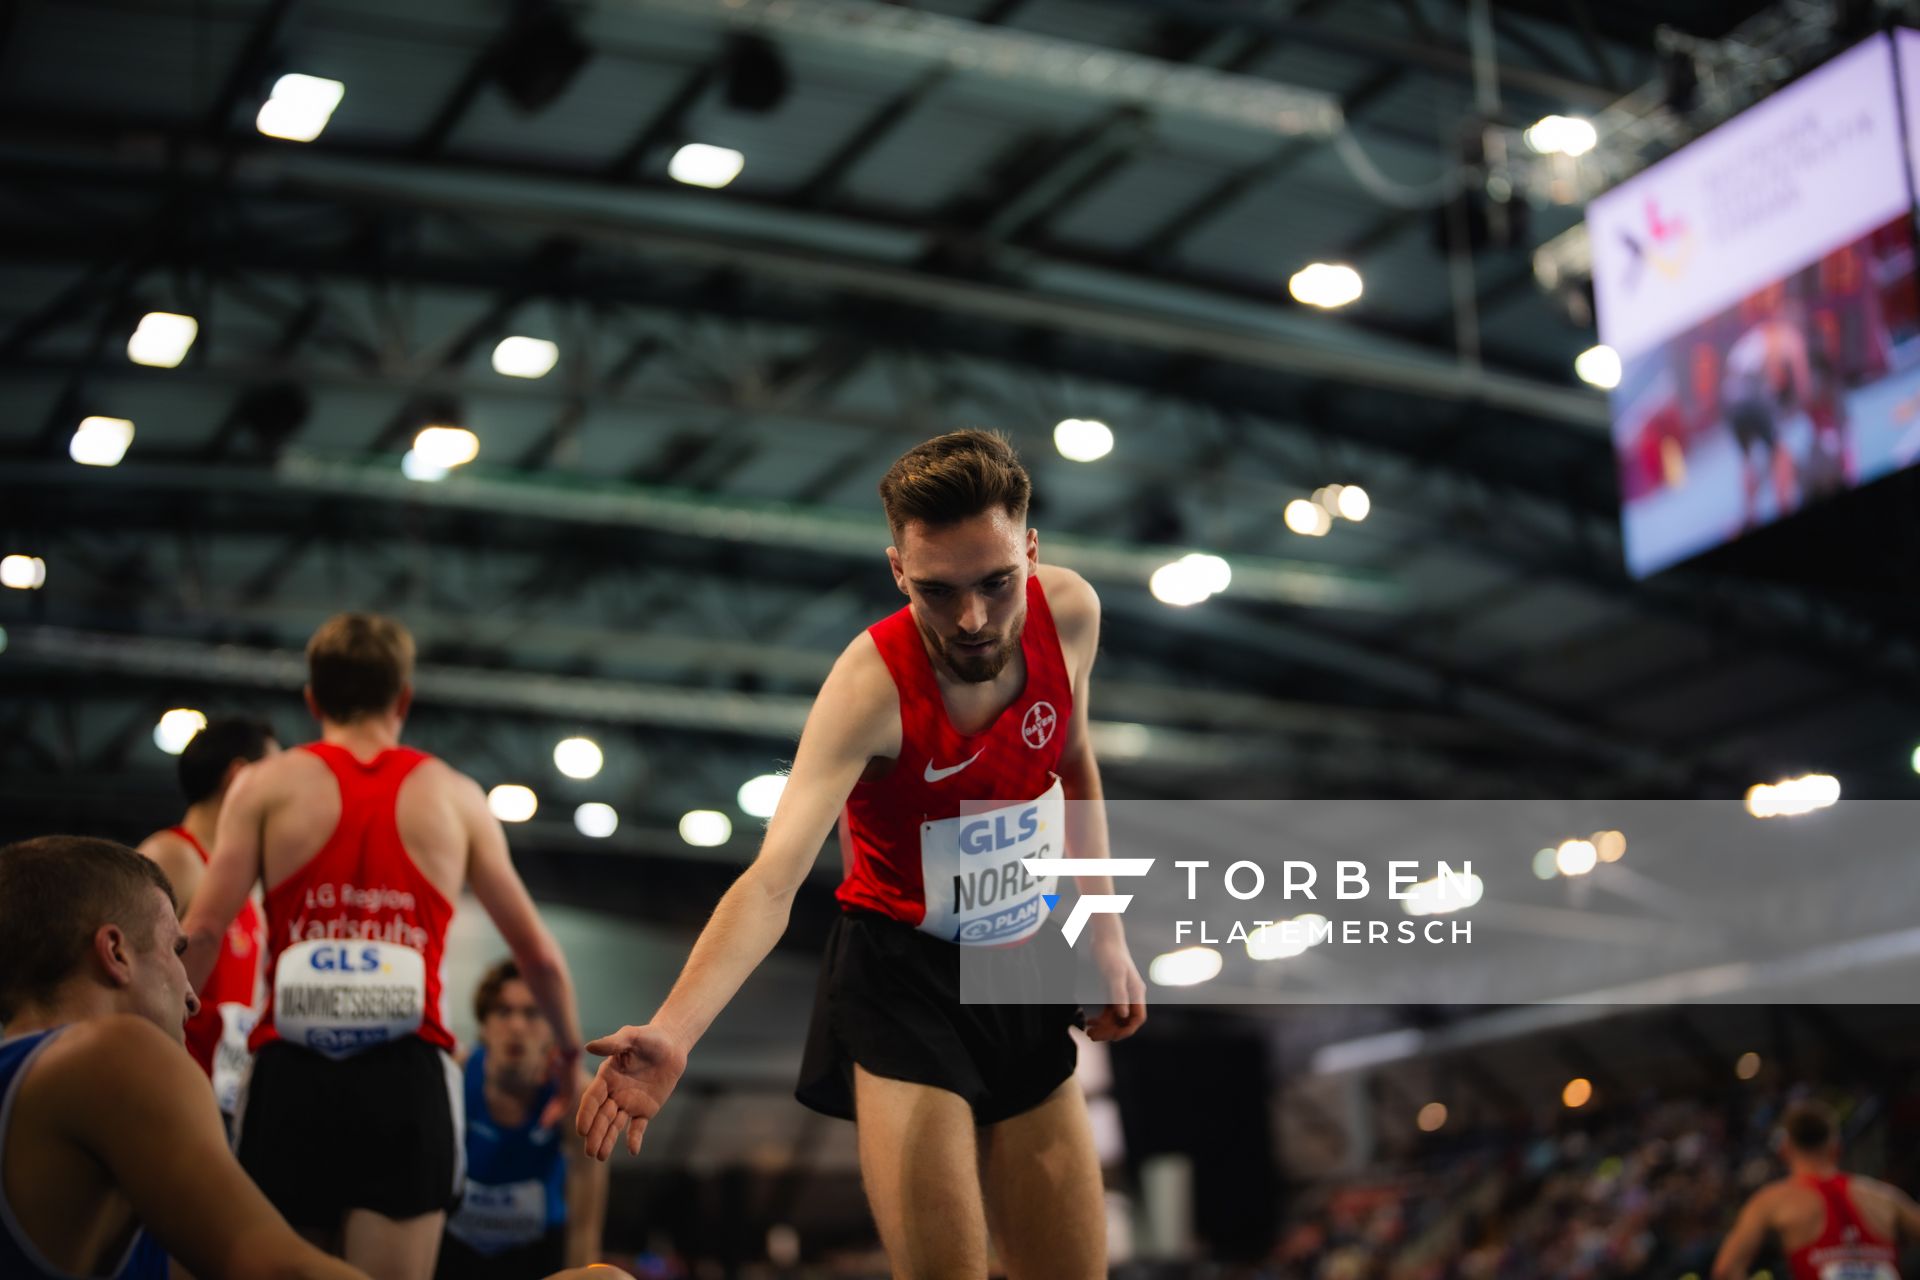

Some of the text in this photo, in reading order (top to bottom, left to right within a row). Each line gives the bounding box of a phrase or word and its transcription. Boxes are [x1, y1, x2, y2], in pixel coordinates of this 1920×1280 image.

[1024, 714, 1055, 736] BAYER
[1034, 706, 1046, 743] BAYER
[341, 883, 416, 914] Region
[995, 901, 1039, 929] PLAN
[288, 912, 428, 953] Karlsruhe
